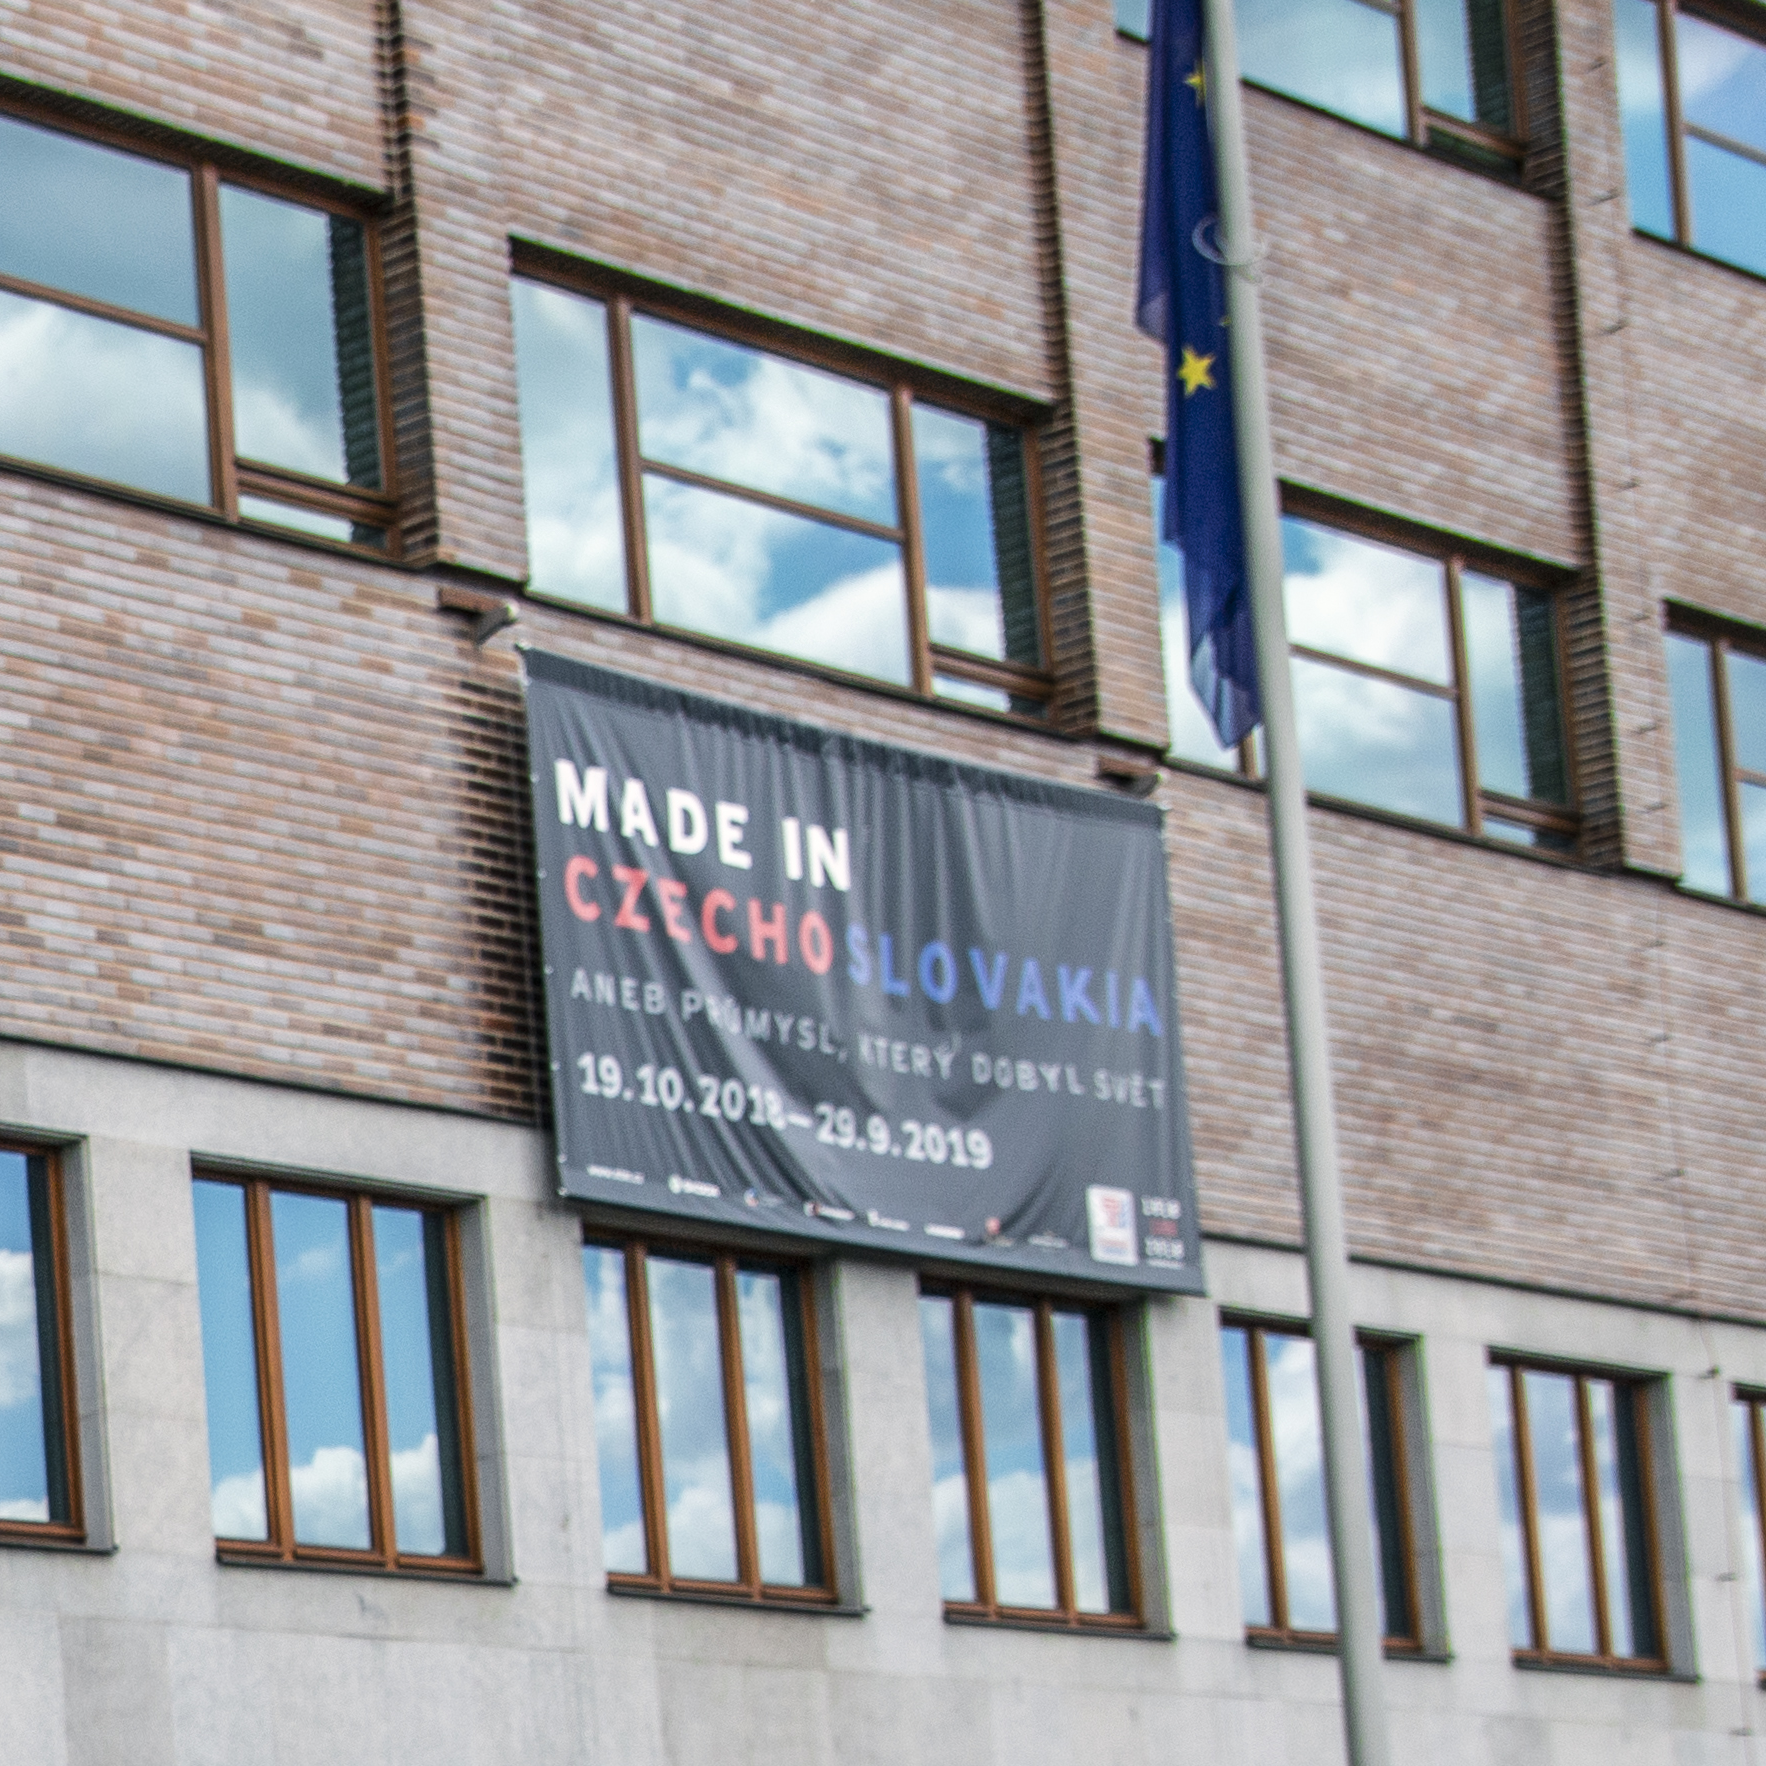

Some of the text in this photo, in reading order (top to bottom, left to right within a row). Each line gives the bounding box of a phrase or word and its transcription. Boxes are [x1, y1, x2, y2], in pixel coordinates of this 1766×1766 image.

[554, 757, 851, 891] MADE IN
[564, 855, 1164, 1037] CZECHOSLOVAKIA
[570, 967, 668, 1015] ANEB
